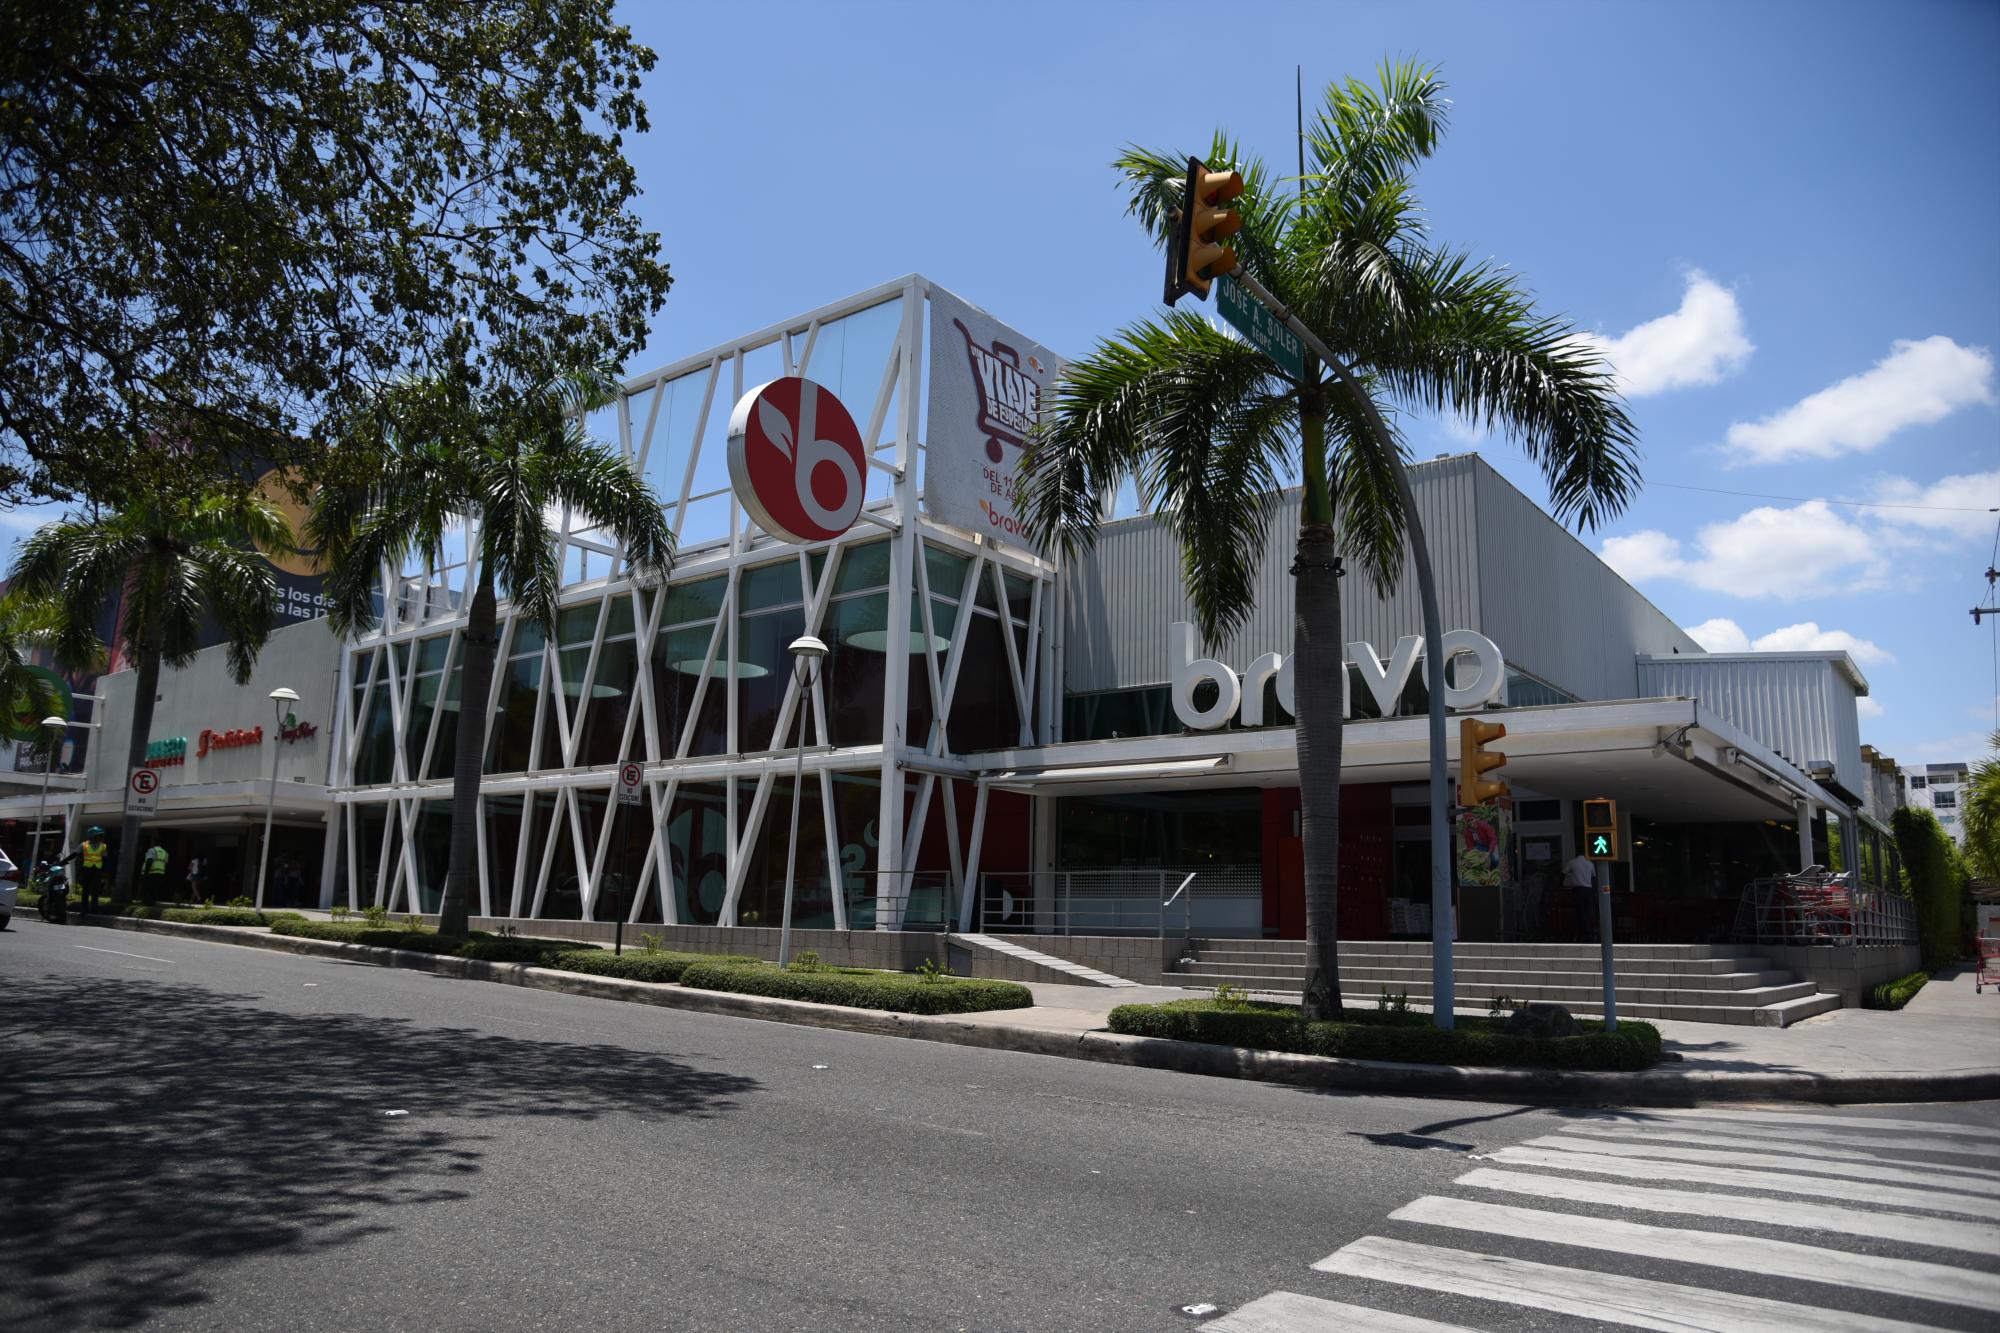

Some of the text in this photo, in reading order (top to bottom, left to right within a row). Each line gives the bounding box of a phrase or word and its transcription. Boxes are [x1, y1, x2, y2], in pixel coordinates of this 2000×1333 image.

[1223, 279, 1298, 358] JOSE A. SOLER
[977, 349, 1037, 423] VIAJE
[986, 396, 999, 420] DE
[795, 378, 863, 532] b
[983, 467, 1013, 488] DEL 11
[991, 482, 1002, 496] DE
[288, 586, 311, 603] los
[288, 602, 311, 619] las
